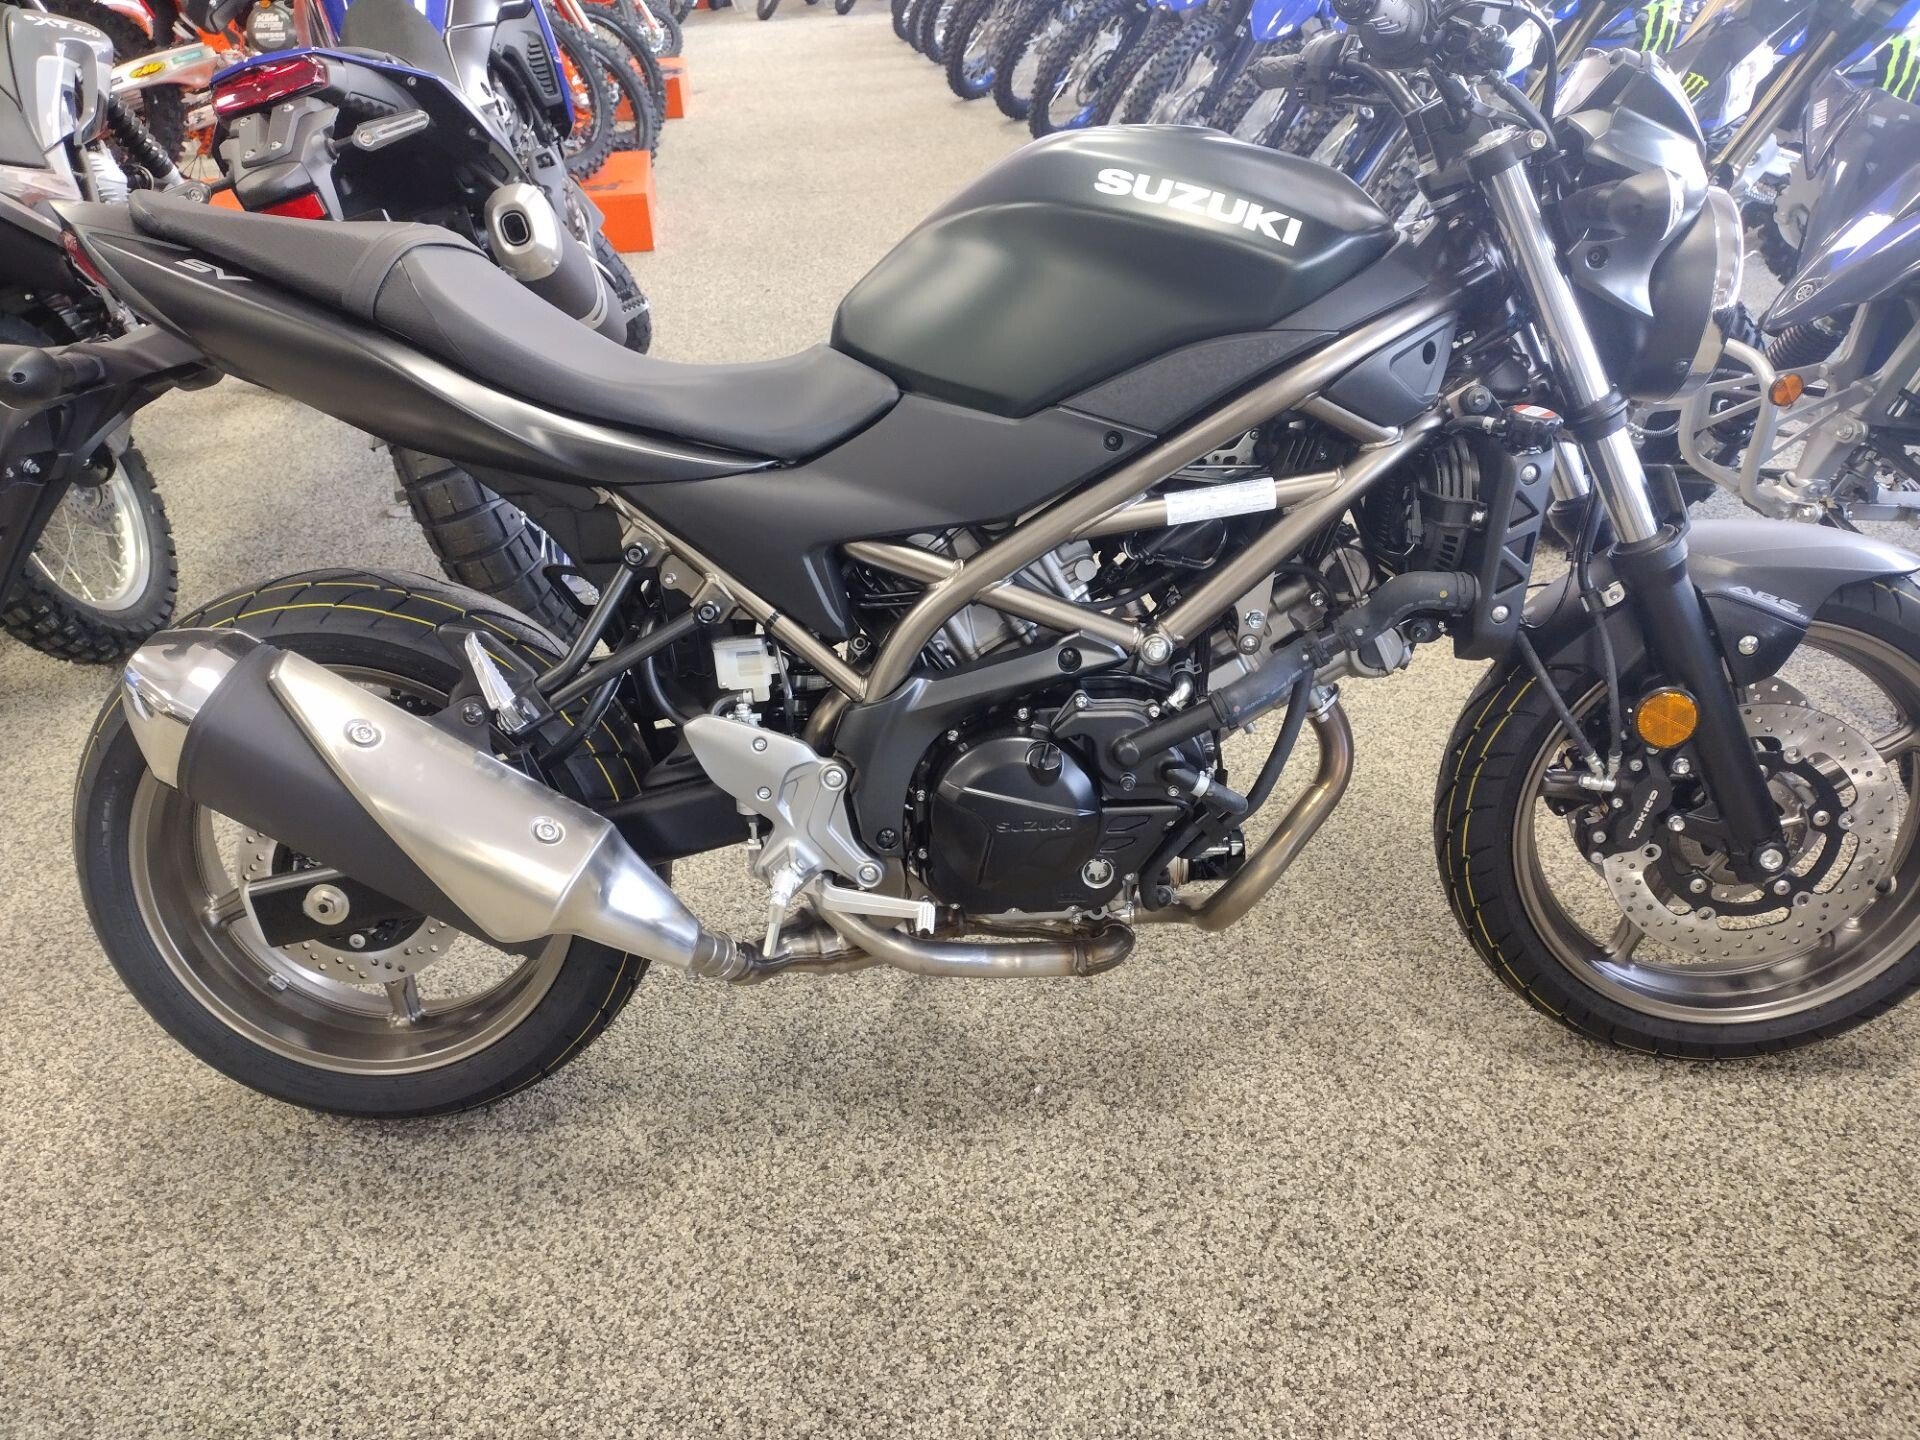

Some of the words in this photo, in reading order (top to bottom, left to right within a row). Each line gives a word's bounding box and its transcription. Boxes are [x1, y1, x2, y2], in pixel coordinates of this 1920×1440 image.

[1094, 168, 1303, 247] SUZUKI
[174, 259, 253, 281] SV
[1728, 585, 1803, 617] ABS
[996, 818, 1071, 833] SUZUKI
[1628, 790, 1659, 839] TOKICO
